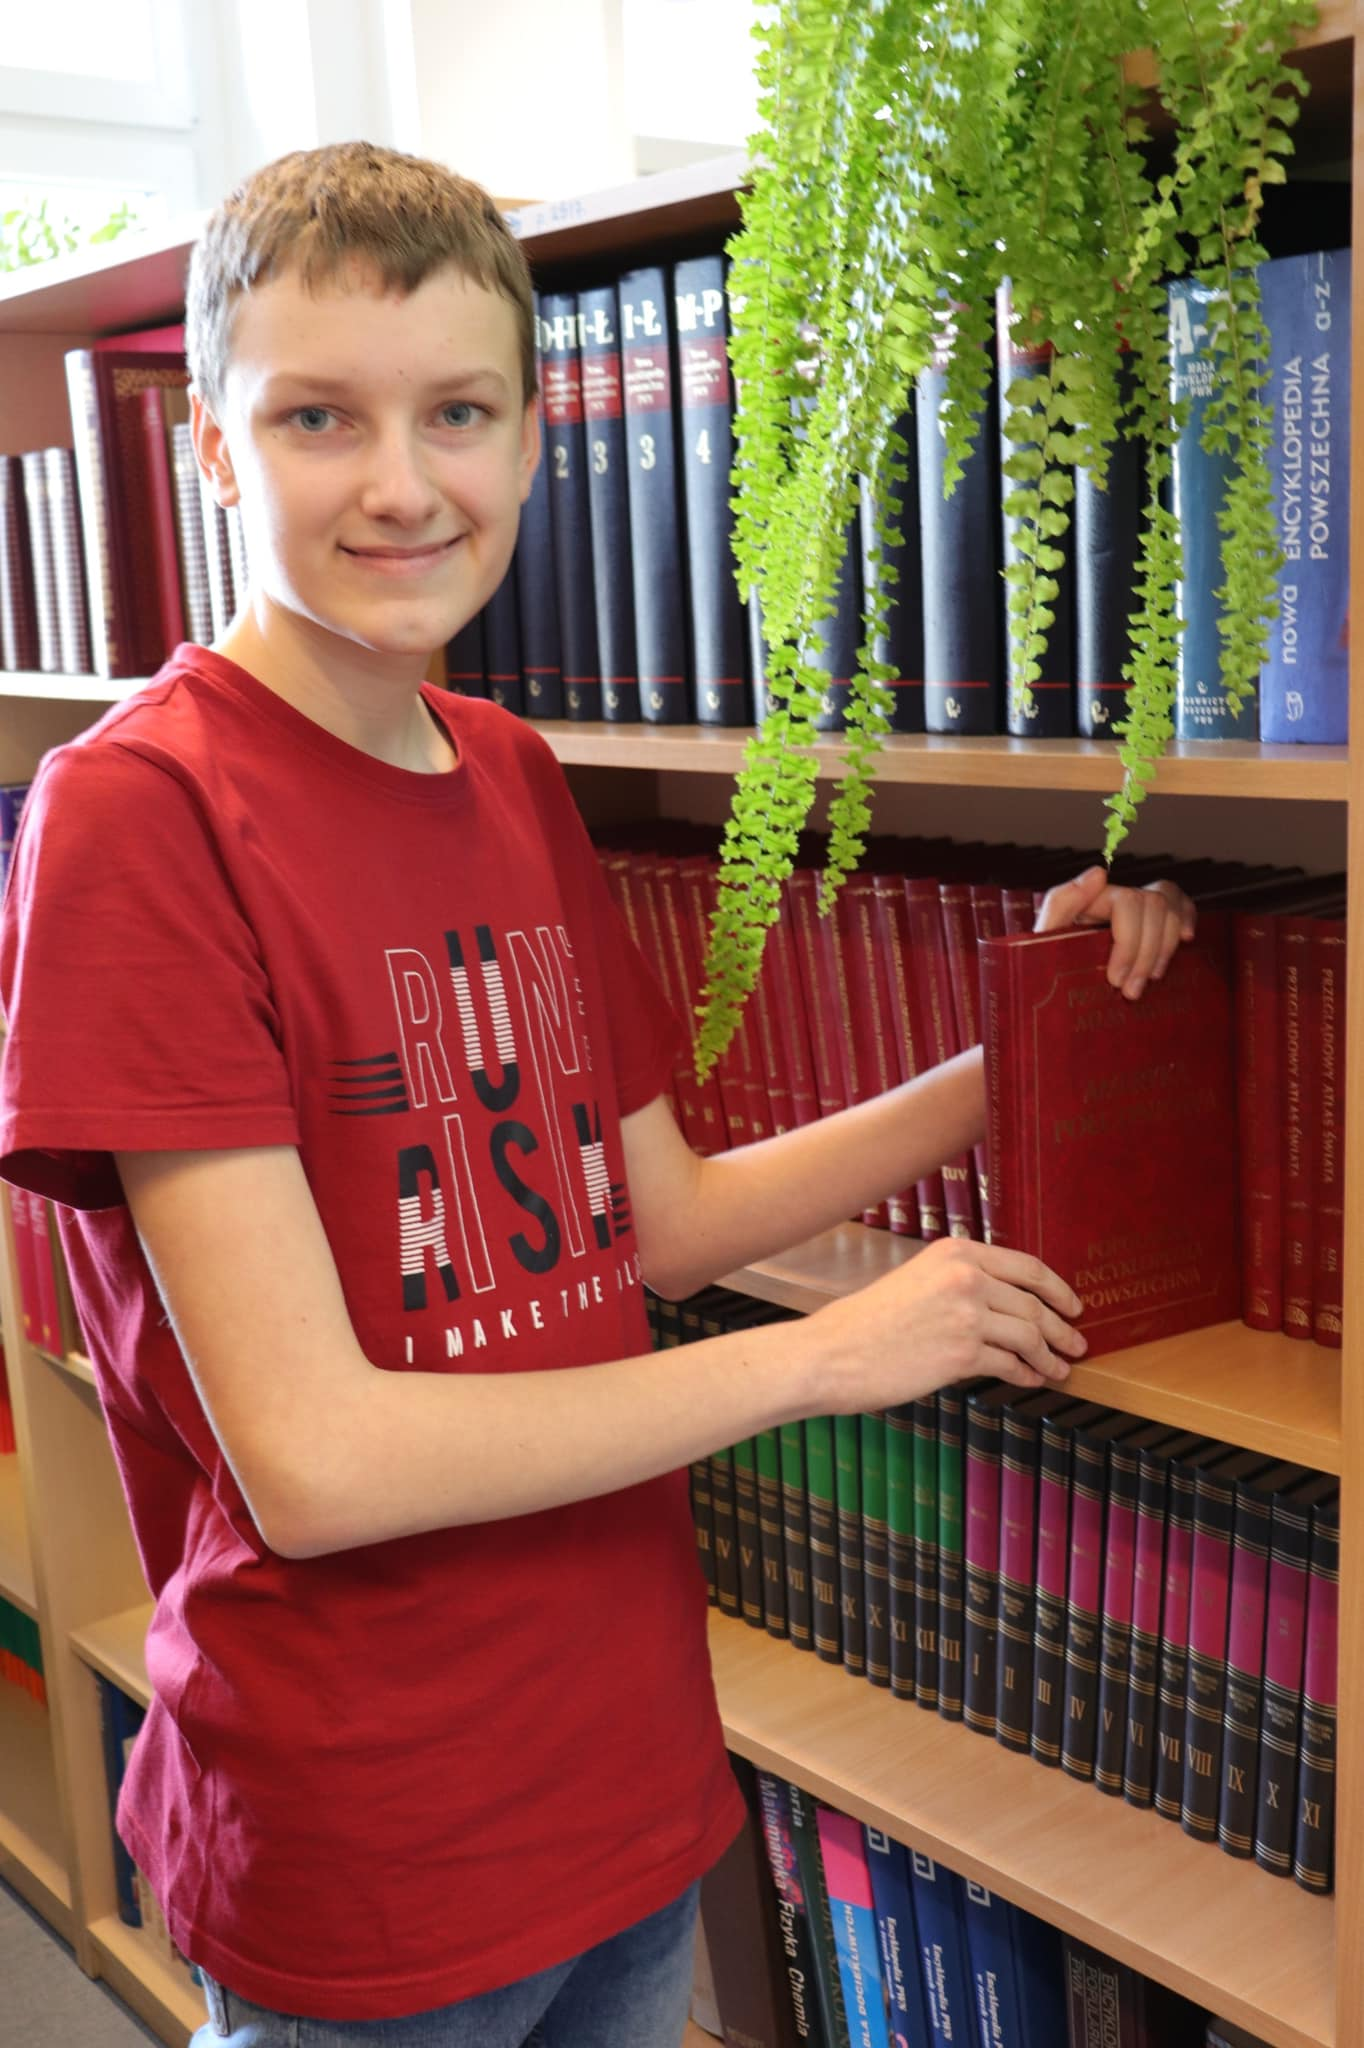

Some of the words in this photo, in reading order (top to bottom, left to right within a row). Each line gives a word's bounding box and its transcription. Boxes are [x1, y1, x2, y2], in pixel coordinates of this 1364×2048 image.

[554, 445, 569, 478] 2
[593, 440, 608, 475] 3
[640, 434, 655, 470] 3
[696, 429, 711, 464] 4
[1282, 356, 1302, 560] ENCYKLOPEDIA
[1309, 352, 1330, 560] POWSZECHNA
[1282, 584, 1298, 664] nowa
[405, 1336, 414, 1363] I
[446, 1300, 545, 1357] MAKE
[560, 1275, 604, 1318] THE
[740, 1545, 753, 1568] V
[869, 1603, 882, 1629] X
[973, 1653, 979, 1676] I
[1005, 1665, 1014, 1690] II
[1038, 1678, 1051, 1705] III
[1070, 1696, 1086, 1720] IV
[1103, 1708, 1113, 1732] V
[1129, 1718, 1144, 1747] VI
[1159, 1731, 1180, 1763] VII
[1187, 1743, 1212, 1777] VIII
[1227, 1764, 1245, 1793] IX
[1266, 1780, 1279, 1809] X
[1302, 1798, 1321, 1829] XI
[778, 1899, 799, 1959] Fizyka
[788, 1967, 810, 2038] Chemia
[1103, 1973, 1117, 2048] ENCYKLO
[941, 2011, 953, 2041] PWN
